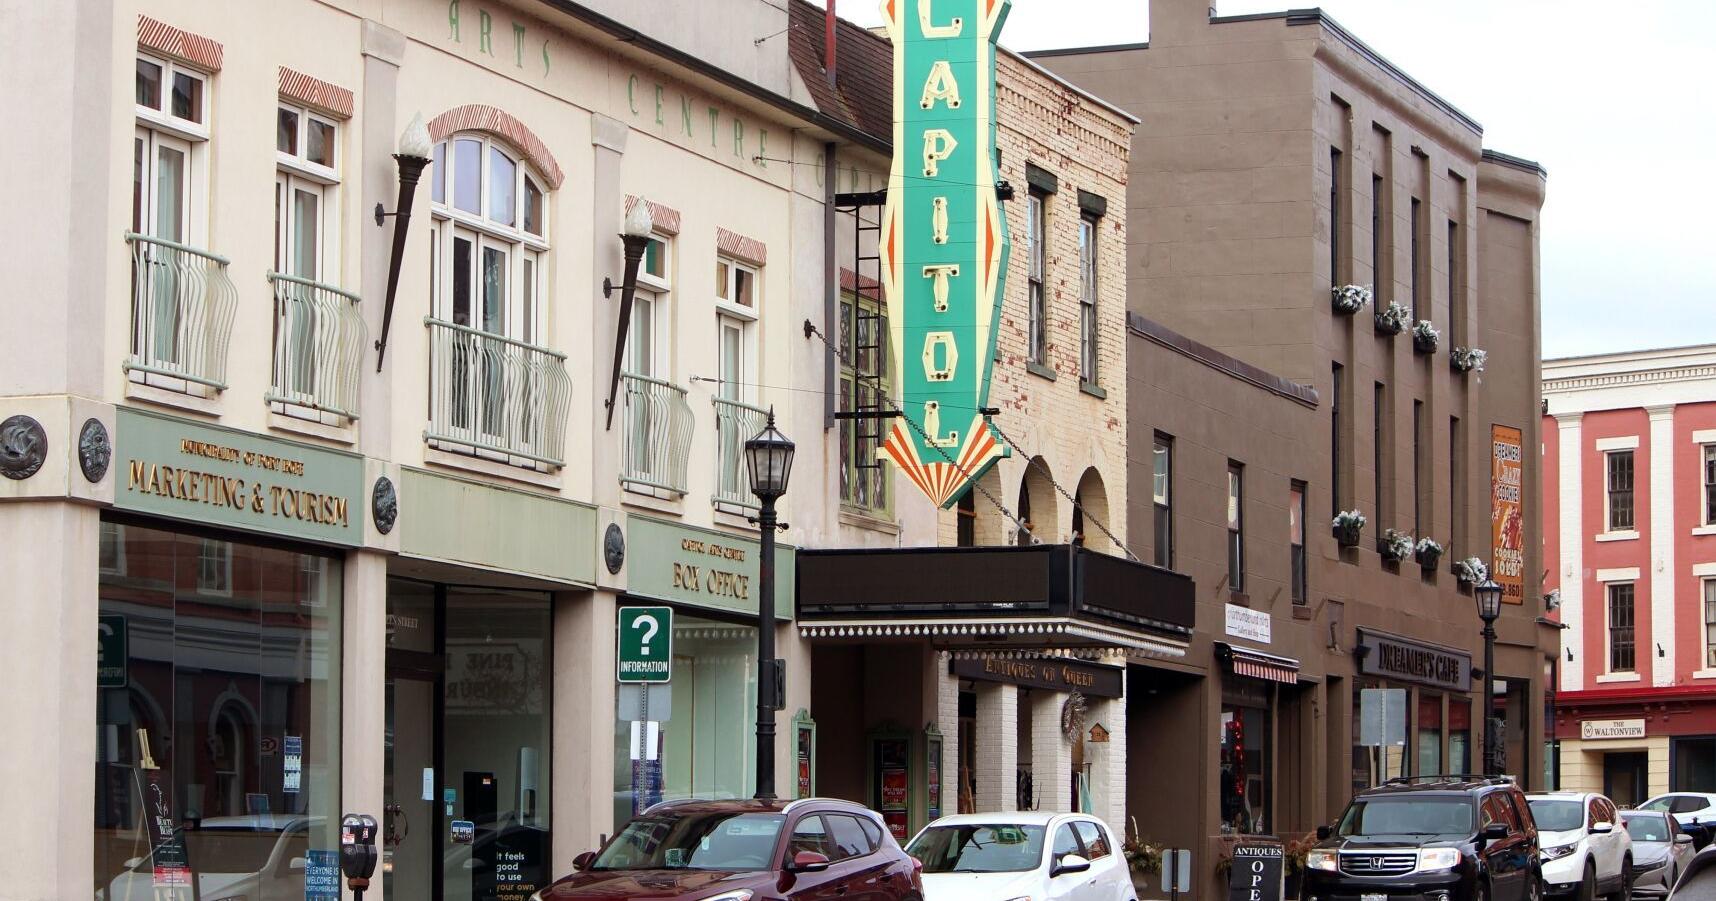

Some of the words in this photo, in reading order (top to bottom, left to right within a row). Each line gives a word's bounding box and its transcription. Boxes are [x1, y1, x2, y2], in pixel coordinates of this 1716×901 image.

[448, 0, 550, 78] ARTS
[628, 74, 769, 168] CENTRE
[917, 0, 964, 448] CAPITOL
[243, 452, 255, 466] OF
[128, 459, 244, 510] MARKETING
[252, 480, 264, 514] &
[270, 486, 348, 527] TOURISM
[673, 562, 700, 592] BOX
[707, 569, 749, 600] OFFICE
[632, 615, 658, 655] ?
[621, 661, 668, 672] INFORMATION
[1378, 642, 1434, 679] DREAMER'S
[1594, 728, 1642, 736] WALTONVIEW
[505, 852, 525, 860] feels
[1235, 848, 1281, 856] ANTIQUES
[306, 867, 332, 875] EVERYONE
[334, 868, 339, 876] IS
[496, 863, 519, 872] good
[306, 876, 332, 885] WELCOME
